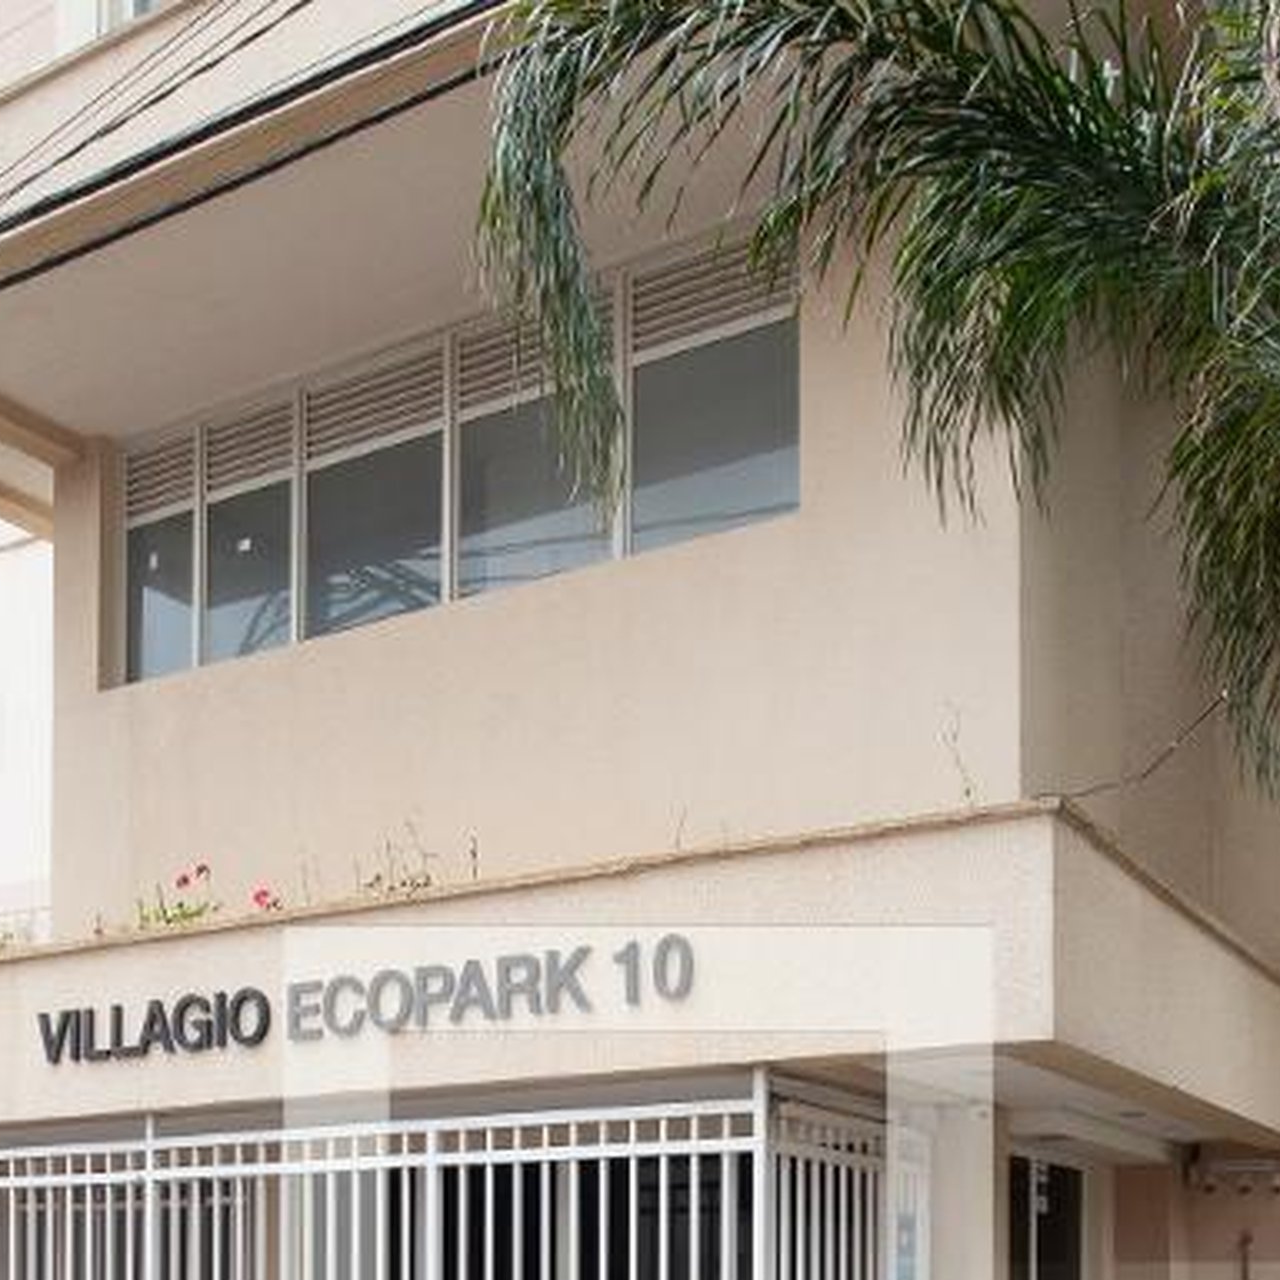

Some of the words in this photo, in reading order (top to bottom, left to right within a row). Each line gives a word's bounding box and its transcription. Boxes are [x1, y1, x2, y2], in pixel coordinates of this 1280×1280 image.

[38, 986, 271, 1065] VILLAGIO
[286, 946, 592, 1041] ECOPARK
[613, 933, 695, 1006] 10
